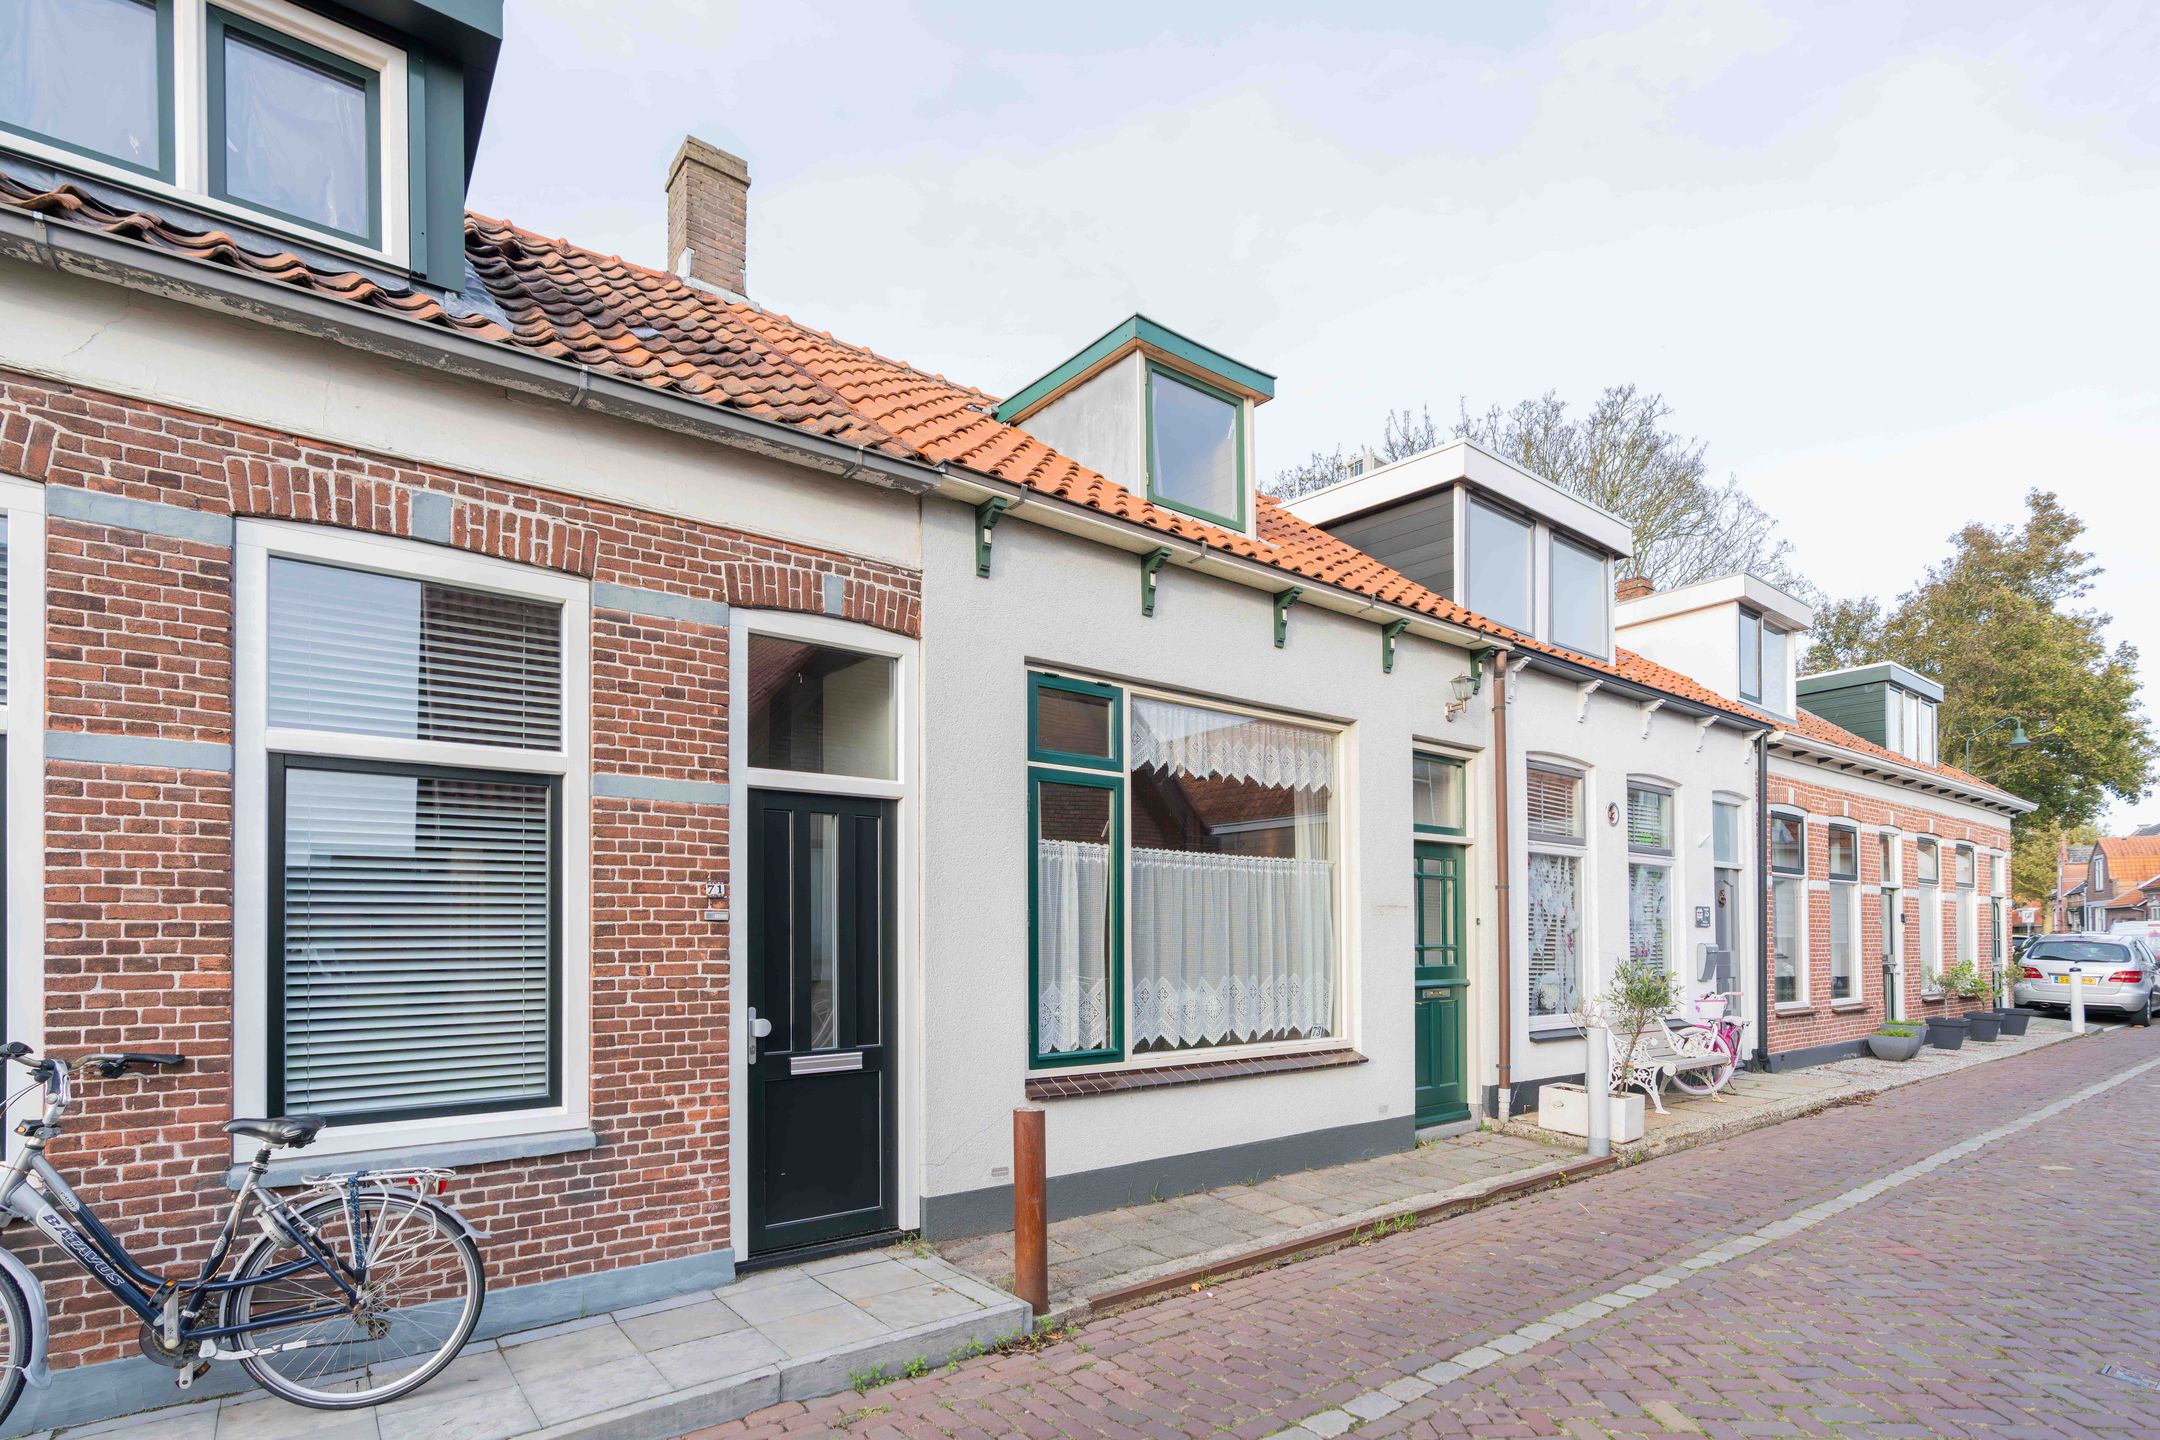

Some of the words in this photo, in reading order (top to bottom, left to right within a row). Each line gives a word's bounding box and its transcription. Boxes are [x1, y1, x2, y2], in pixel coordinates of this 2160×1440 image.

[707, 884, 723, 895] 71
[1312, 1026, 1322, 1037] 73
[42, 1214, 126, 1287] BATAVUS
